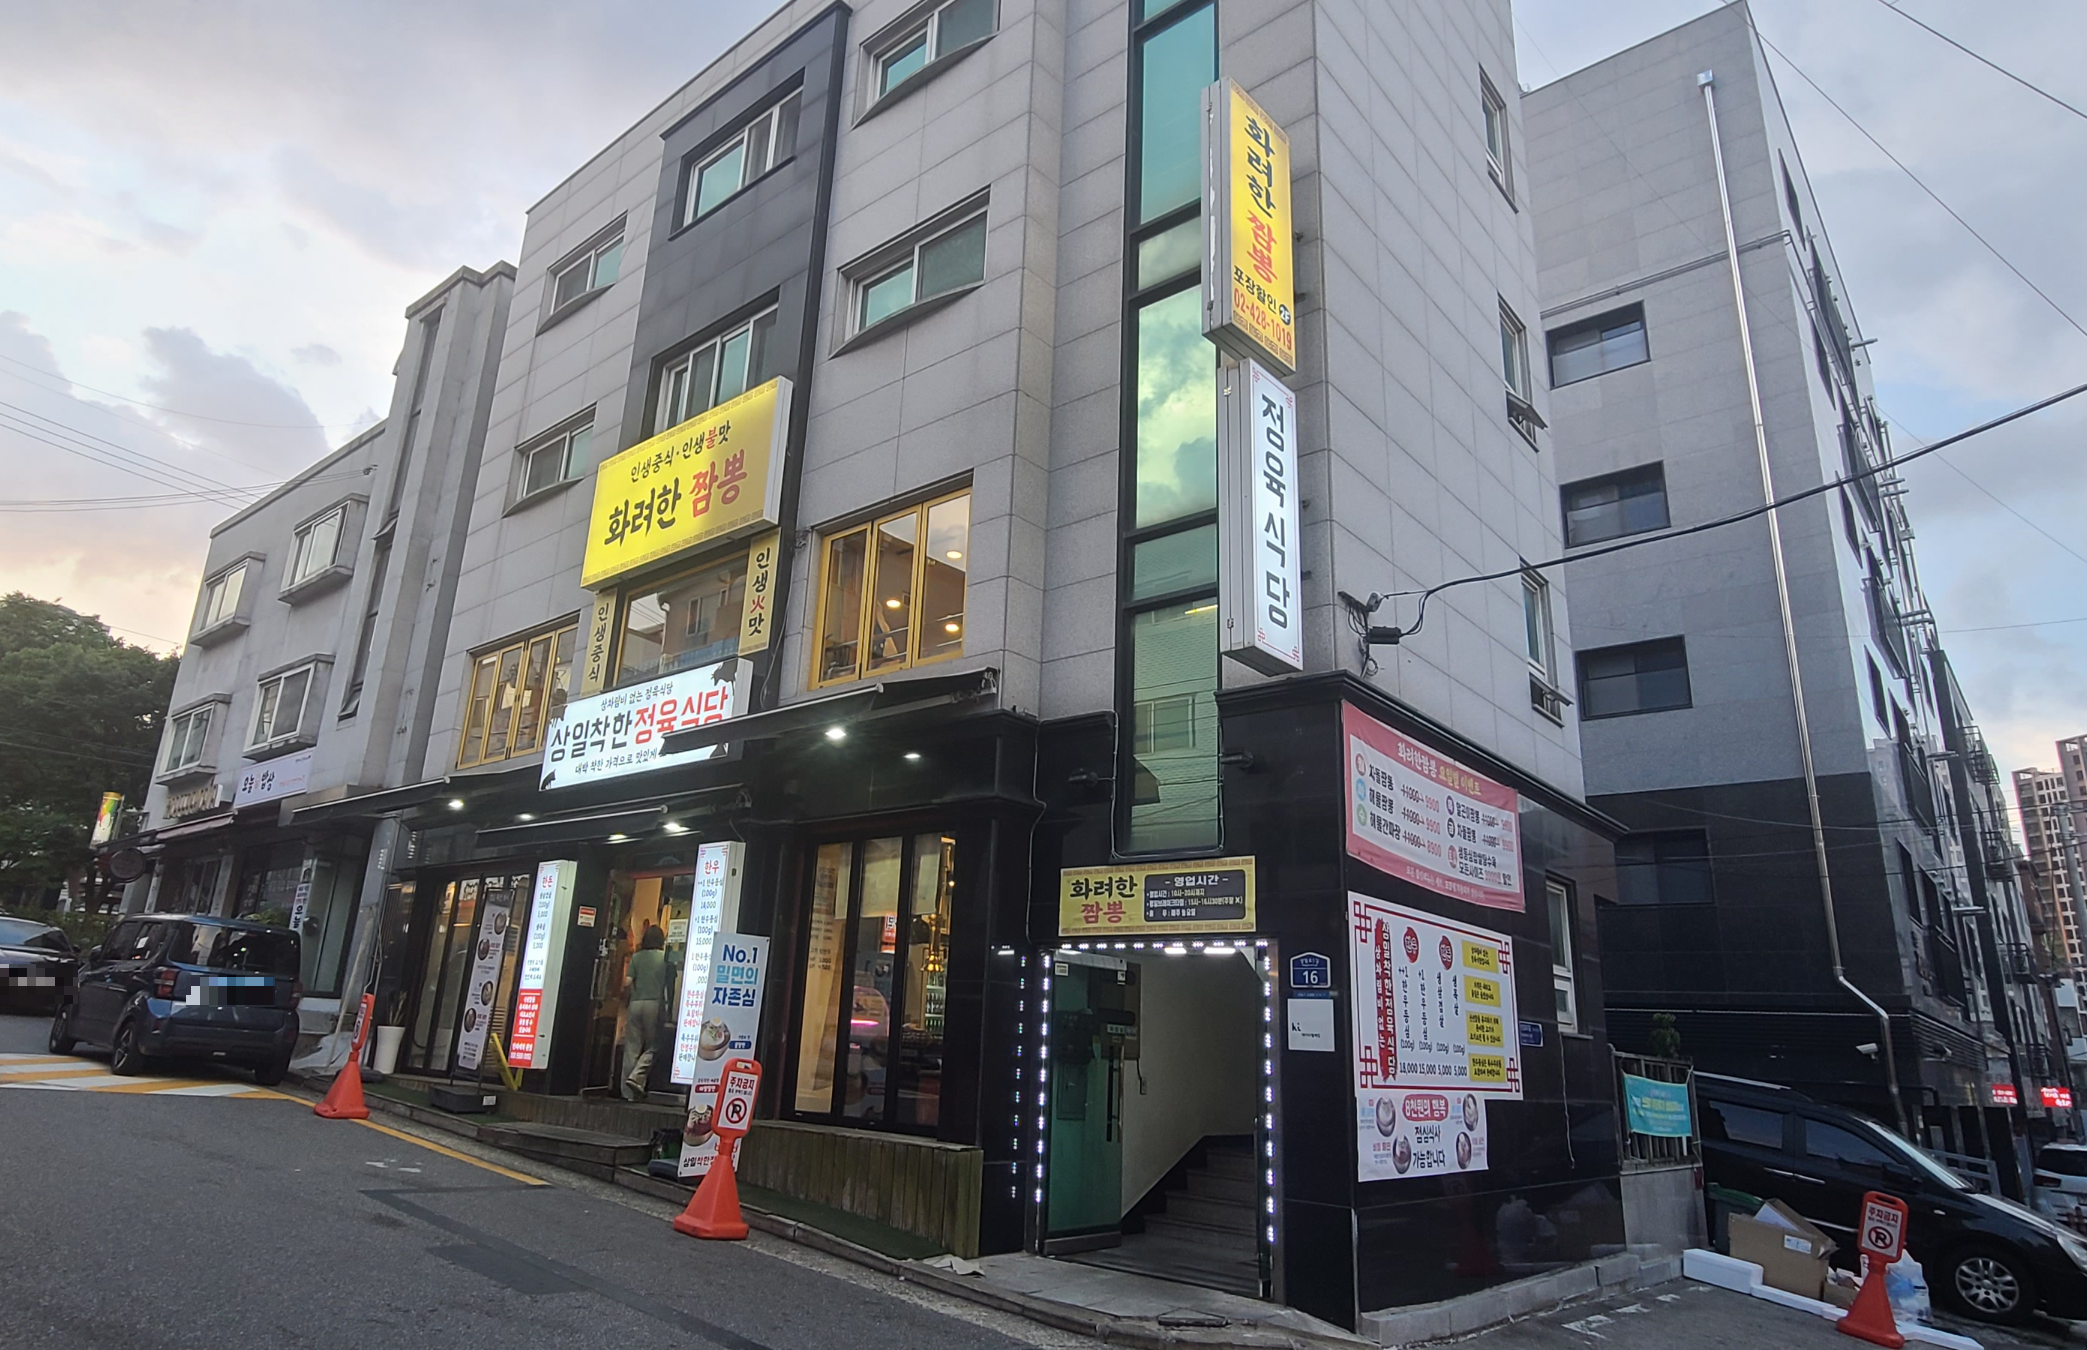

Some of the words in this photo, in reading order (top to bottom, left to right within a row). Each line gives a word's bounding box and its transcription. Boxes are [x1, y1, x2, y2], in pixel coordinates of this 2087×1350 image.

[1245, 115, 1277, 218] 화려한
[1233, 264, 1277, 314] 포장할인
[1233, 287, 1292, 351] 02-428-1019
[630, 446, 675, 483] 인생중식
[682, 420, 731, 459] 인생불맛
[603, 476, 682, 547] 화려한
[688, 448, 748, 518] 짬뽕
[1262, 392, 1291, 630] 정육식당
[588, 604, 608, 683] 인생중식
[550, 710, 633, 762] 상일착한
[634, 686, 729, 745] 정육식당
[704, 860, 720, 875] 한우
[1070, 875, 1138, 900] 화려한
[1174, 874, 1220, 887] 영업시간
[1081, 900, 1127, 924] 짬뽕
[722, 945, 758, 964] No.1
[716, 965, 759, 985] 밀면의
[1302, 970, 1319, 984] 16
[711, 987, 756, 1007] 자존심
[730, 1077, 755, 1090] 주차금지
[1415, 1125, 1441, 1144] 점심식사
[1869, 1206, 1899, 1224] 주차금지
